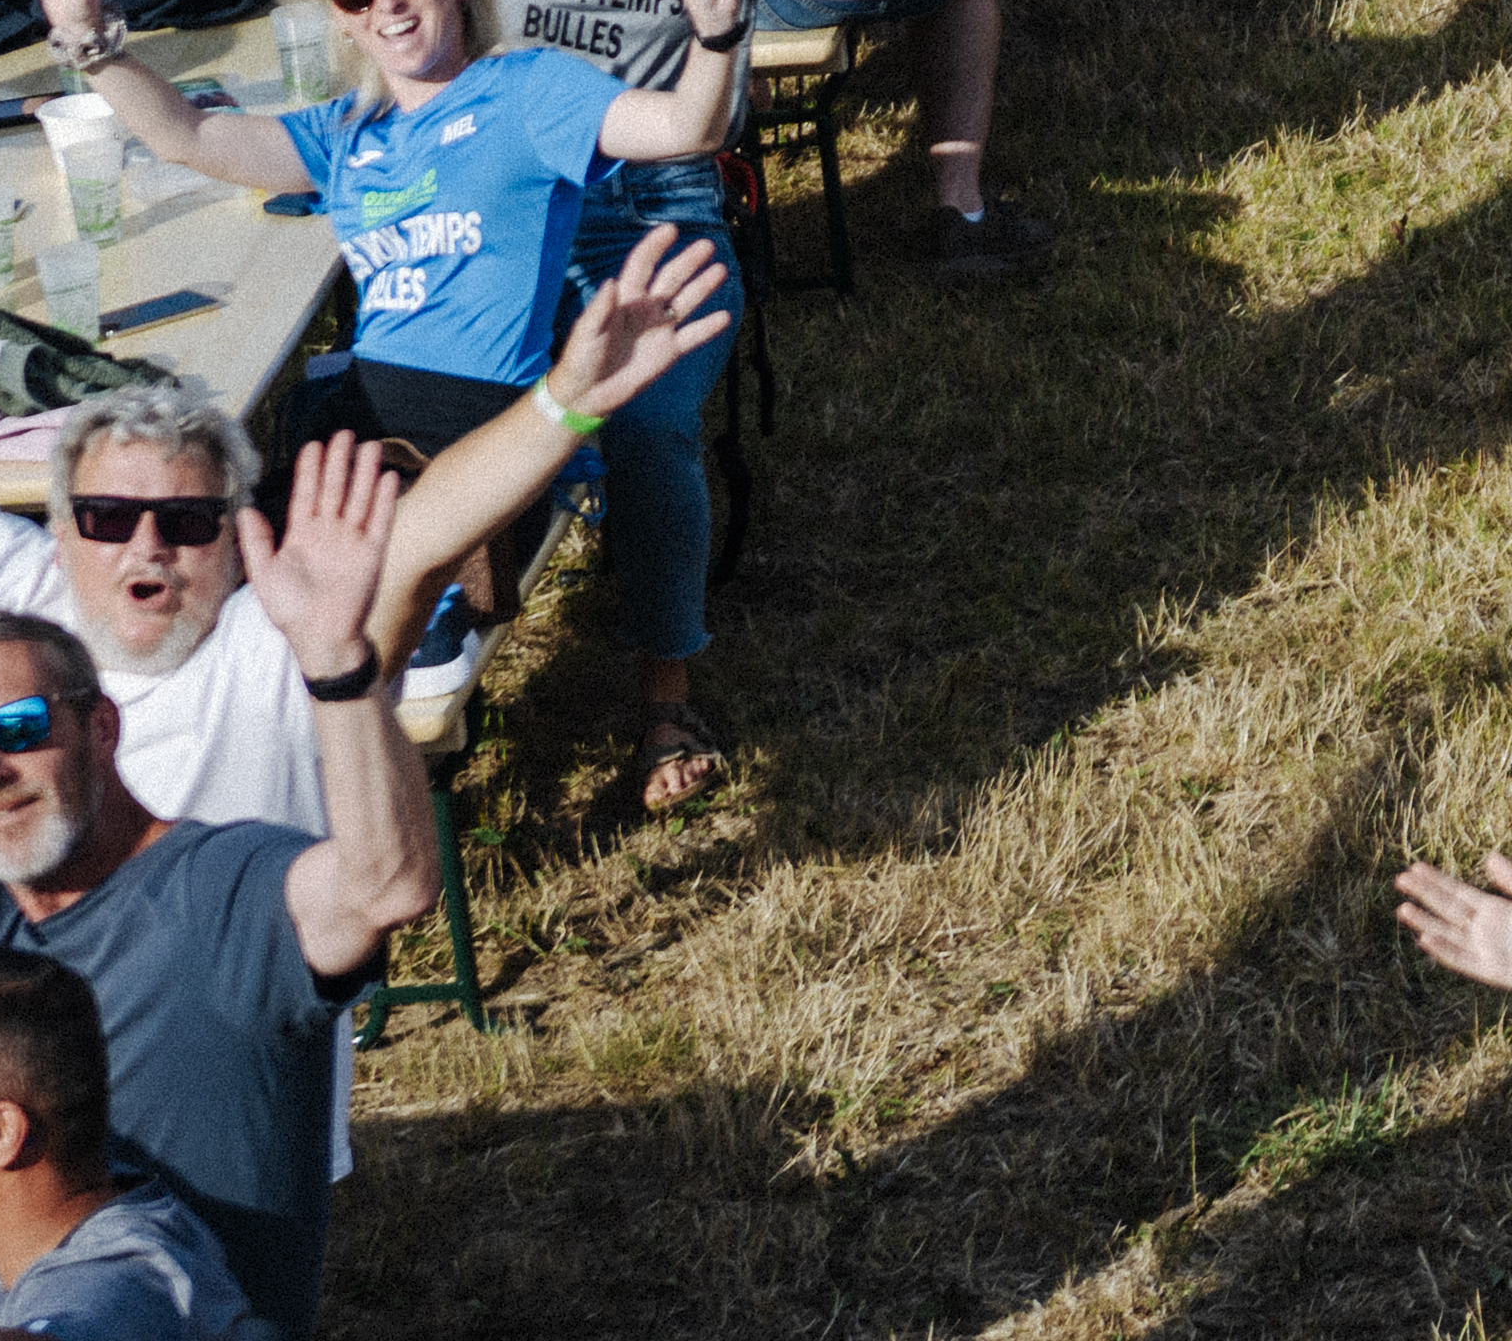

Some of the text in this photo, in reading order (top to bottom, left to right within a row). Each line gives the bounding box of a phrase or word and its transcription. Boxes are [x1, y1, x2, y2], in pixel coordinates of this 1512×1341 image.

[524, 4, 625, 59] BULLES
[440, 113, 478, 146] MEL
[399, 211, 483, 258] TEMPS
